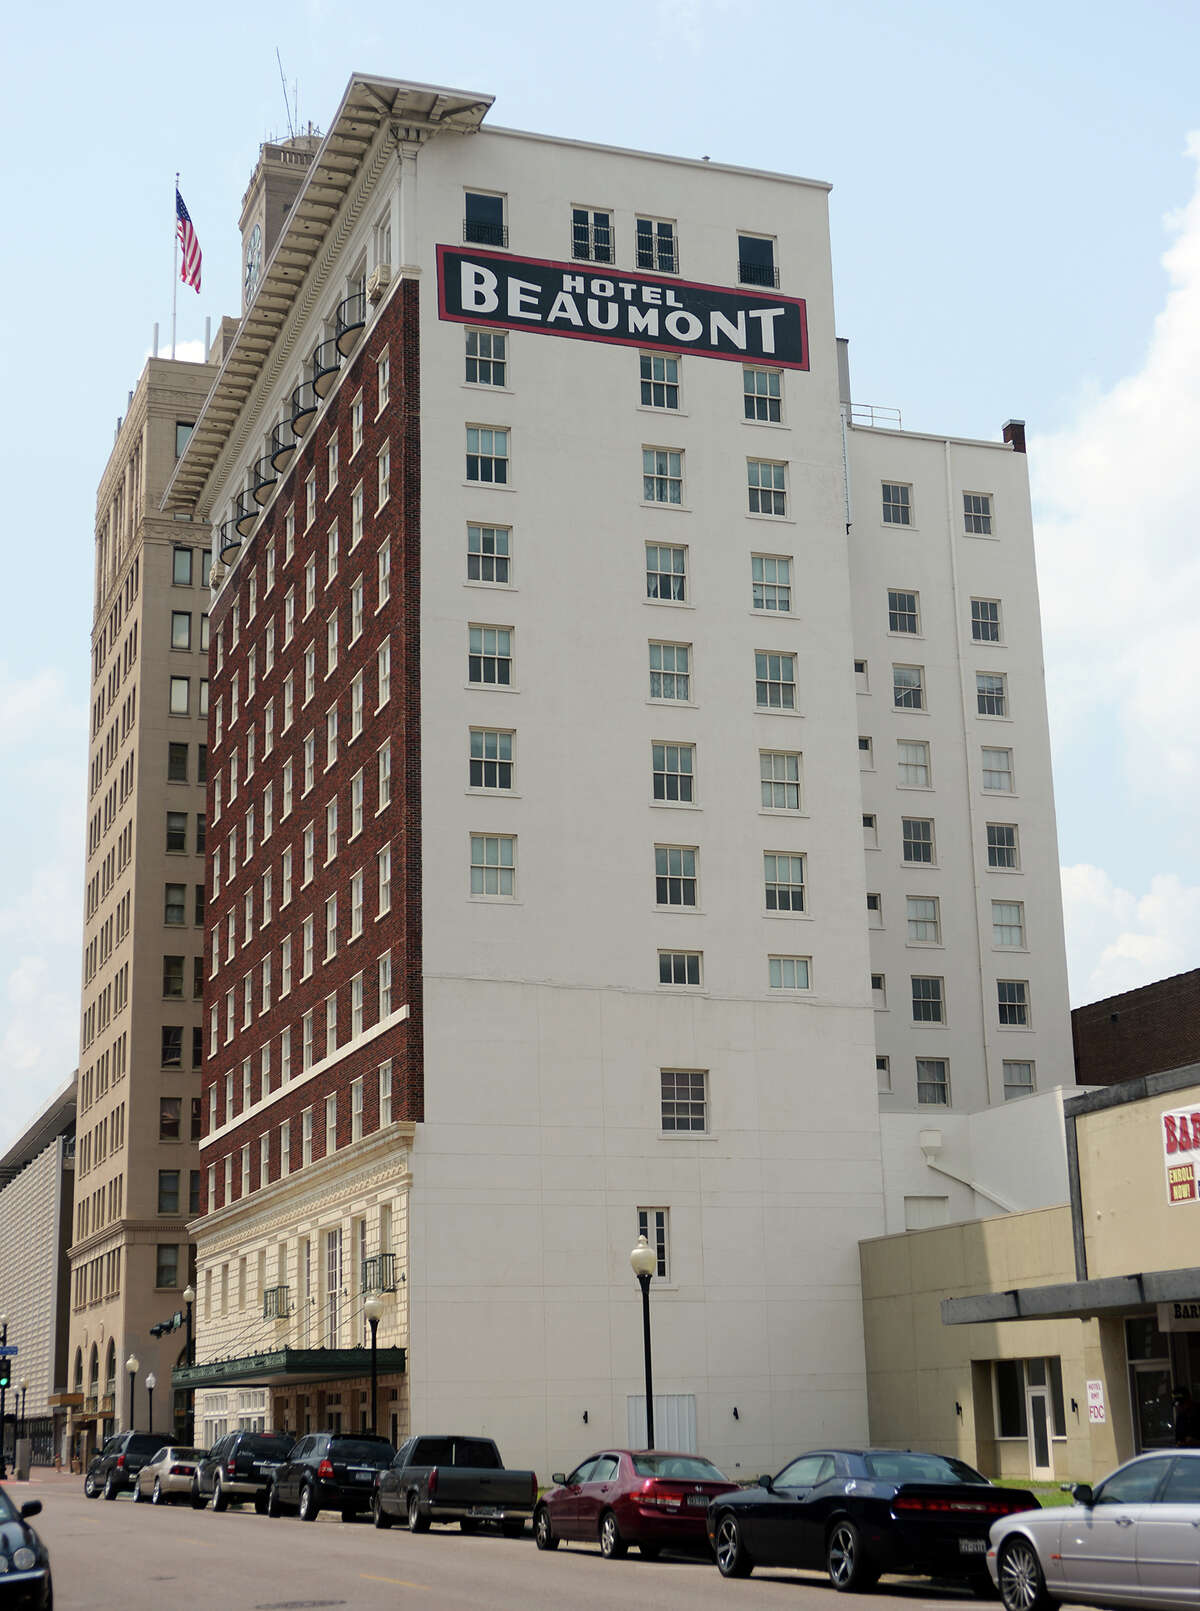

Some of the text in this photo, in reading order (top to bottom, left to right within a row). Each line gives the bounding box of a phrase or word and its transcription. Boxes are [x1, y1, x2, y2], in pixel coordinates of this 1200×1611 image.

[562, 273, 683, 308] HOTEL
[460, 260, 785, 354] BEAUMONT
[1168, 1166, 1194, 1184] ENROLL
[1172, 1184, 1191, 1201] NOW!
[1174, 1303, 1200, 1319] BAR
[1089, 1405, 1105, 1419] FDC
